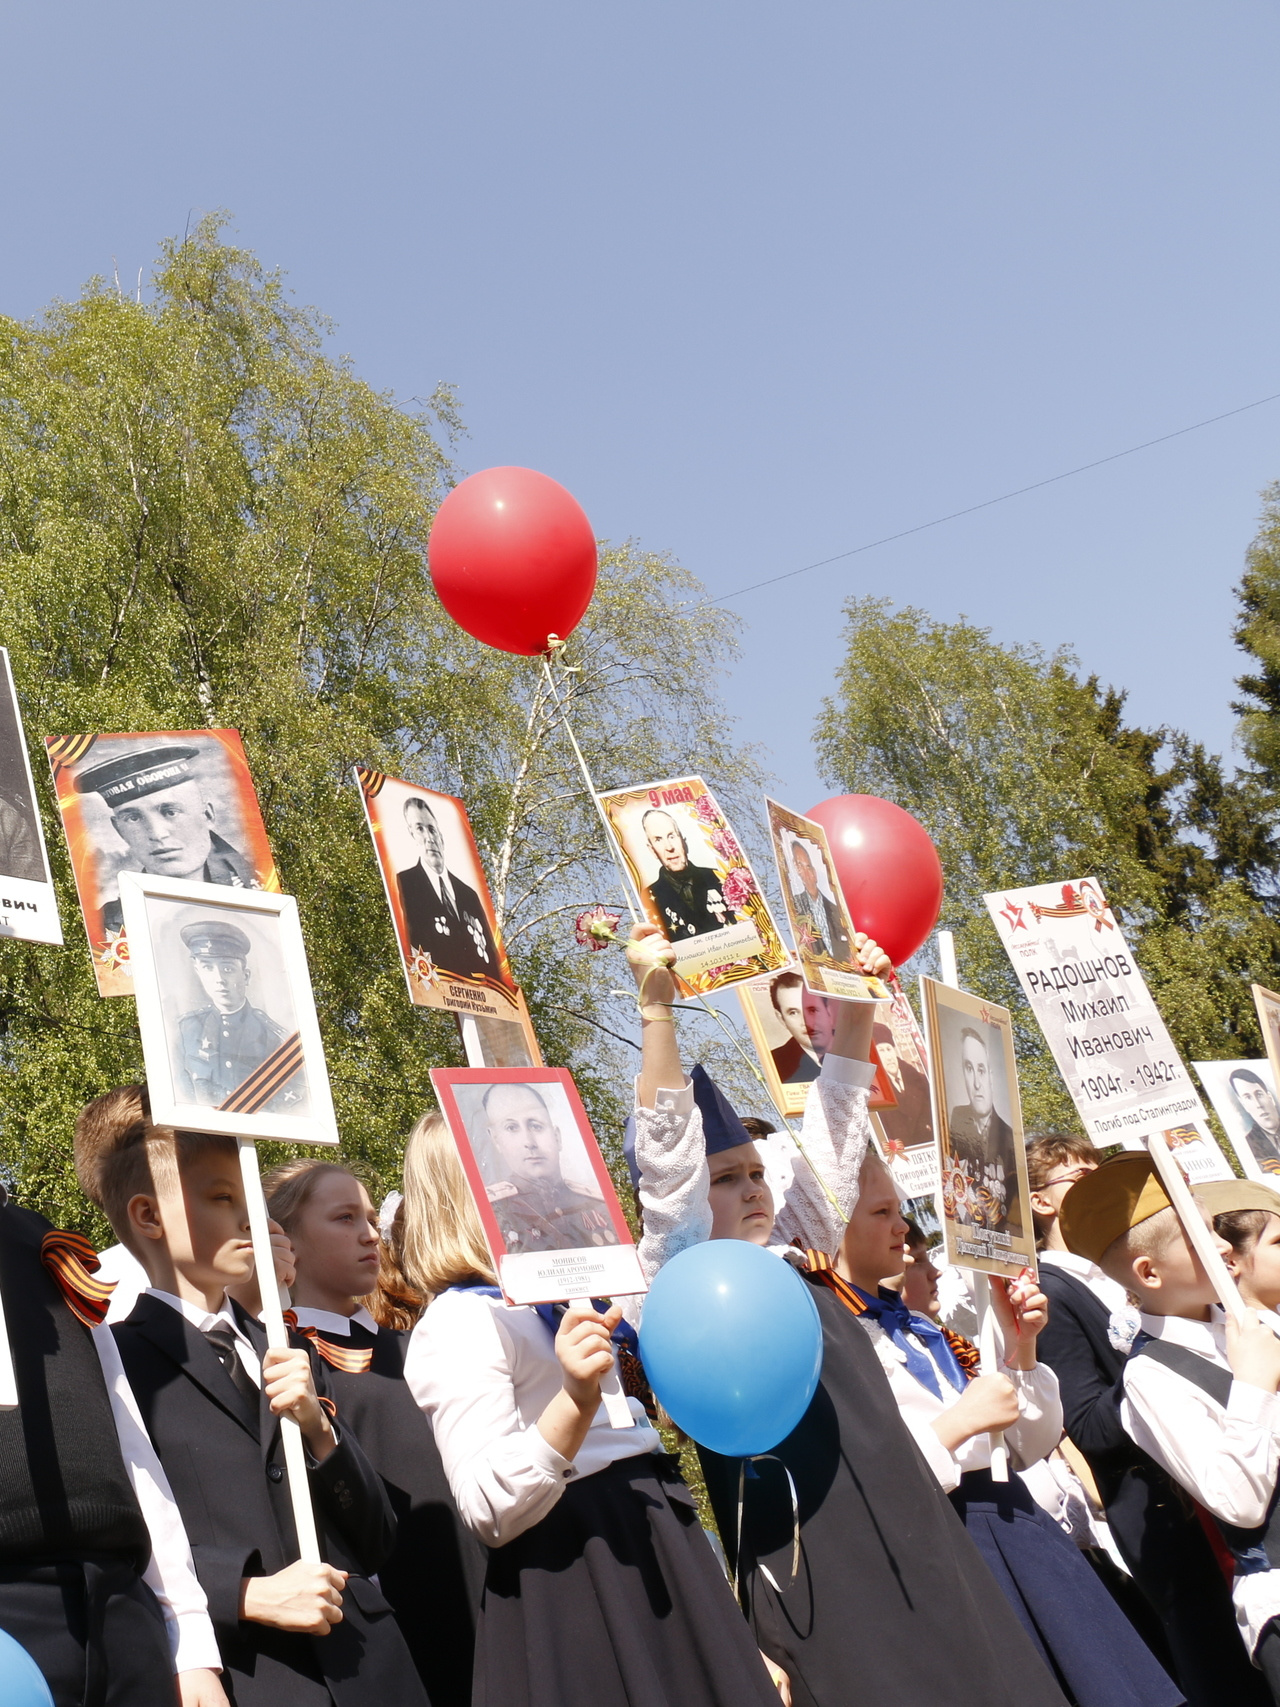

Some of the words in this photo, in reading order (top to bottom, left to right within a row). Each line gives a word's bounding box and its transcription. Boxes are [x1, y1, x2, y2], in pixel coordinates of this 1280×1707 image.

[136, 766, 181, 786] ОБОРОНА
[648, 789, 661, 808] 9
[707, 944, 722, 953] Иван
[723, 934, 757, 950] Леонтьевич
[1026, 954, 1132, 995] РАДОШНОВ
[449, 985, 487, 1002] СЕРГИЕНКО
[443, 996, 472, 1010] Григорий
[471, 1001, 498, 1015] Кузьмич
[1060, 995, 1130, 1023] Михаил
[1066, 1026, 1154, 1060] Иванович
[1081, 1073, 1128, 1101] 1904г.
[1136, 1060, 1181, 1087] 1942г.
[1094, 1115, 1122, 1133] Погиб
[1122, 1113, 1141, 1126] под
[1139, 1099, 1198, 1121] Сталинградом
[894, 1165, 929, 1183] Григорий
[909, 1178, 936, 1191] Старший
[537, 1266, 566, 1277] ЮЛИАН
